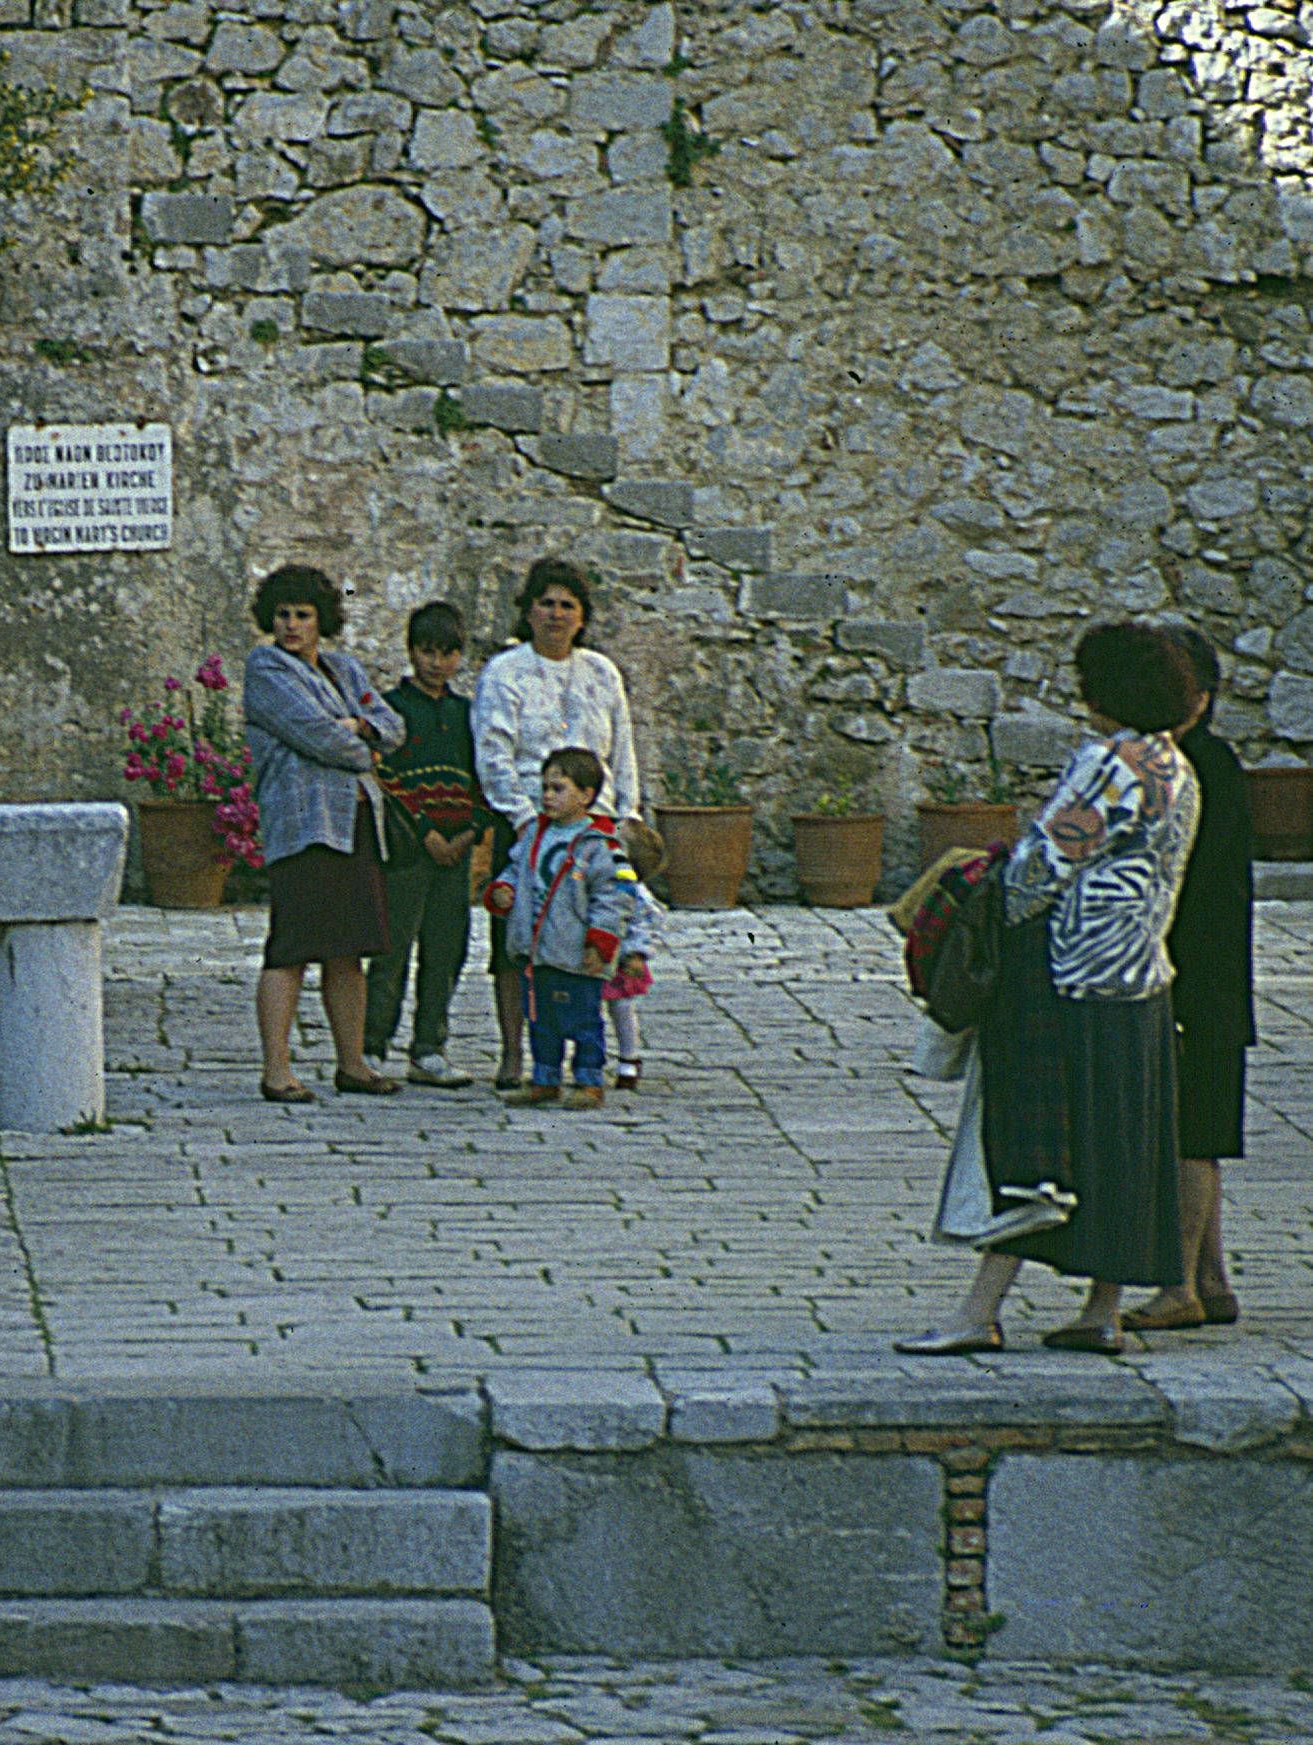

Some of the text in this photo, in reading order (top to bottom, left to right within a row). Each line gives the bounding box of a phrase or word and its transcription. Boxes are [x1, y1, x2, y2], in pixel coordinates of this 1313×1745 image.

[55, 445, 91, 462] ΝΑΟΝ
[96, 443, 165, 462] ΘΕΟΤΟΚΟΥ
[106, 470, 156, 489] KIRCHE
[13, 499, 35, 518] VERS
[83, 498, 95, 517] DE
[98, 497, 132, 516] SAINTE
[14, 523, 168, 546] TO VIRGIN MARY'S CHURCH
